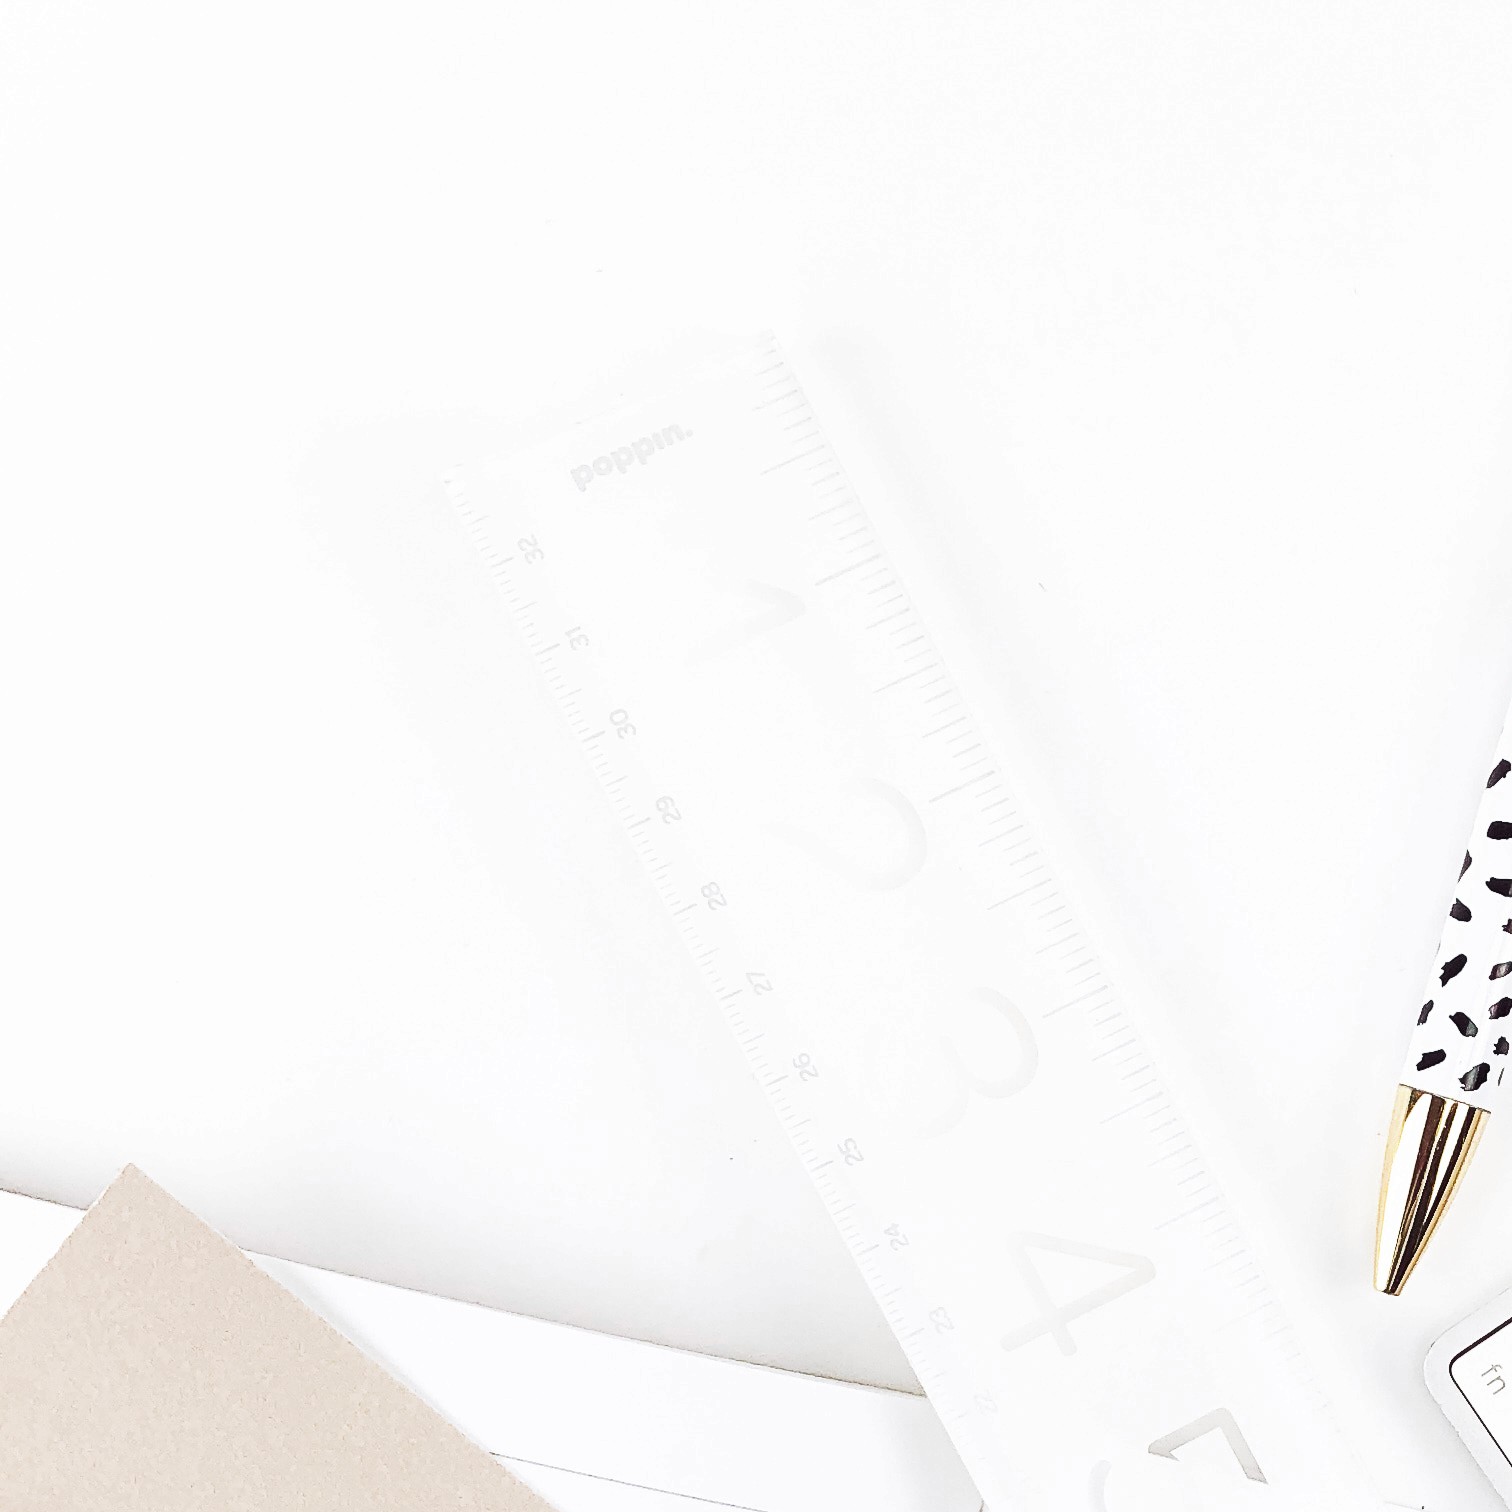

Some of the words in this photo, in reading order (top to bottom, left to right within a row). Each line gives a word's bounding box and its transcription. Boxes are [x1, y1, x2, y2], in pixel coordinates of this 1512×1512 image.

[517, 533, 545, 565] 32
[564, 625, 590, 652] 31
[608, 707, 638, 741] 30
[655, 795, 682, 825] 29
[700, 881, 728, 911] 28
[745, 970, 774, 997] 27
[792, 1051, 820, 1082] 26
[836, 1136, 865, 1167] 25
[1000, 1229, 1157, 1357] 4
[1480, 1363, 1507, 1396] fn
